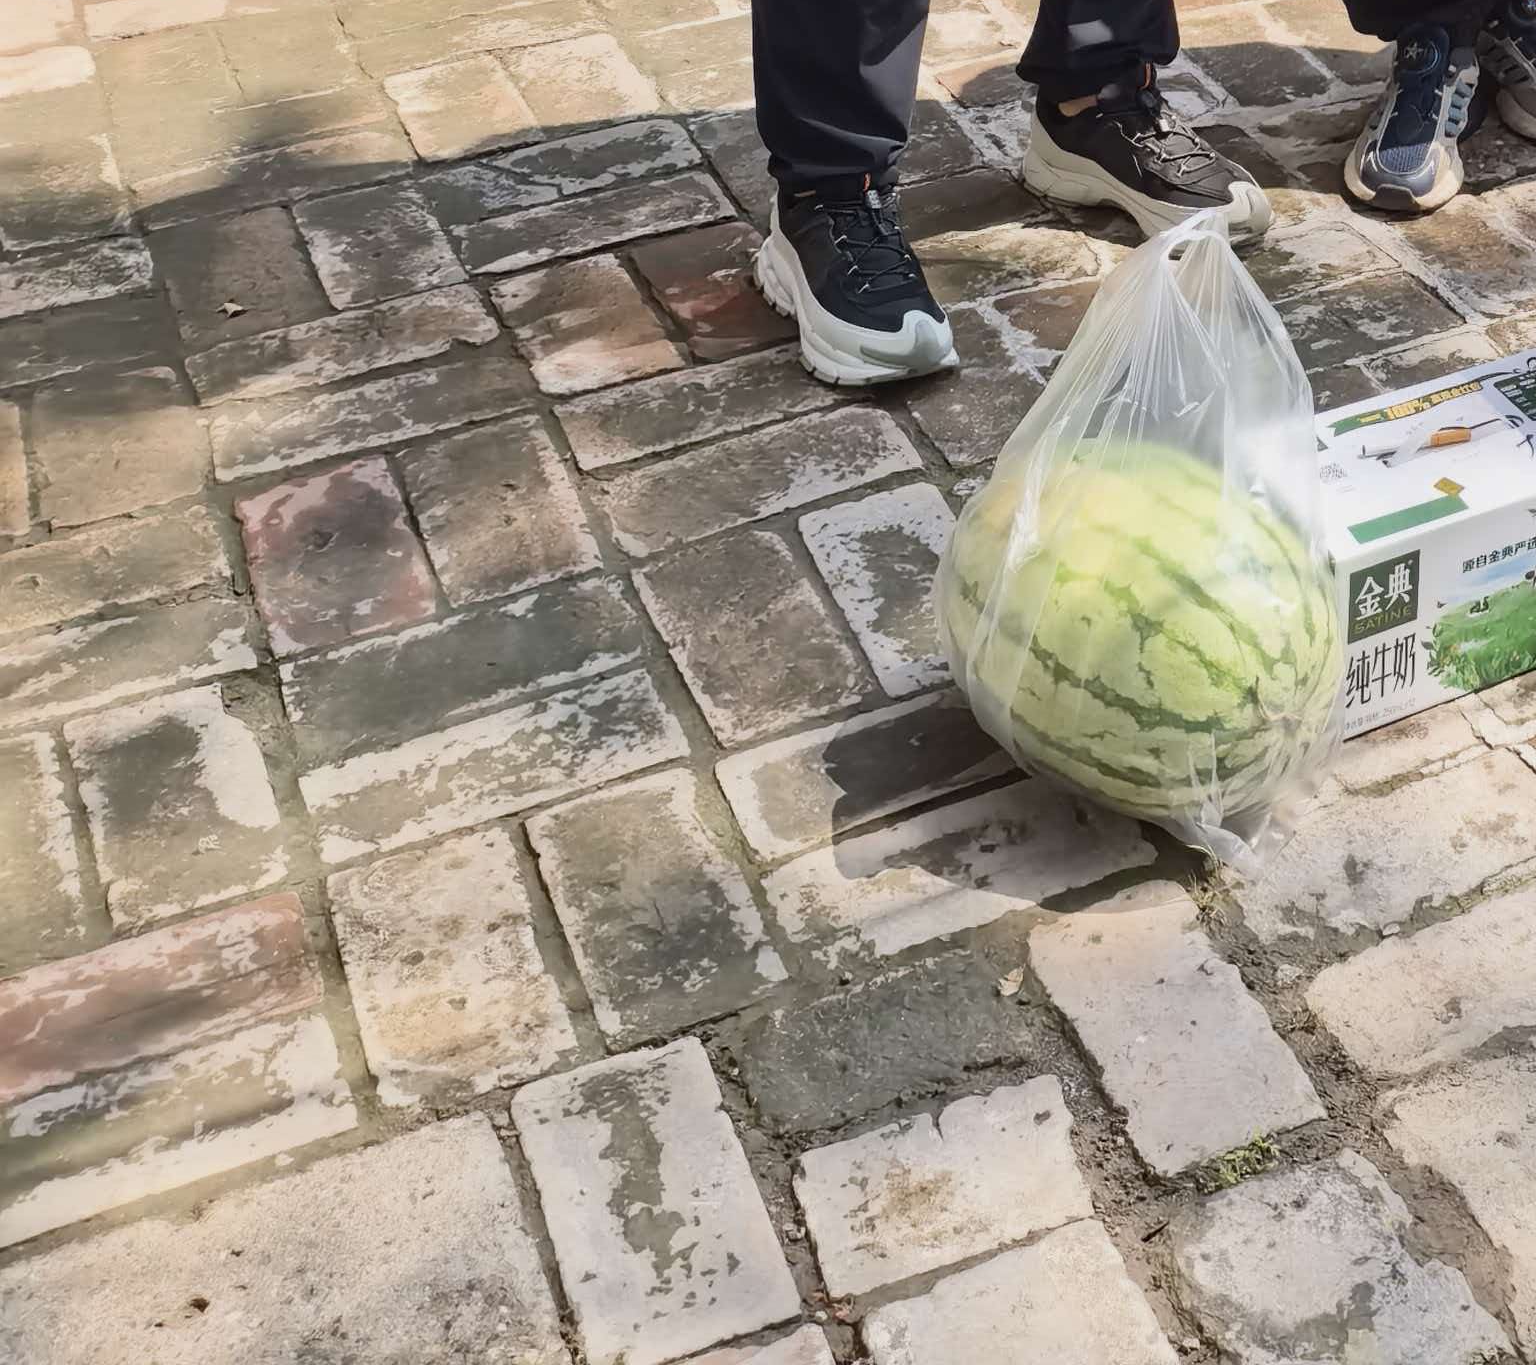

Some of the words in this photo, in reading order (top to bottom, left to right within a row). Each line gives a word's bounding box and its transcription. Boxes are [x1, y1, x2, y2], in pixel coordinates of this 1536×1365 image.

[1355, 563, 1413, 621] 金典
[1355, 606, 1412, 634] SATINE
[1346, 632, 1416, 709] 纯牛奶
